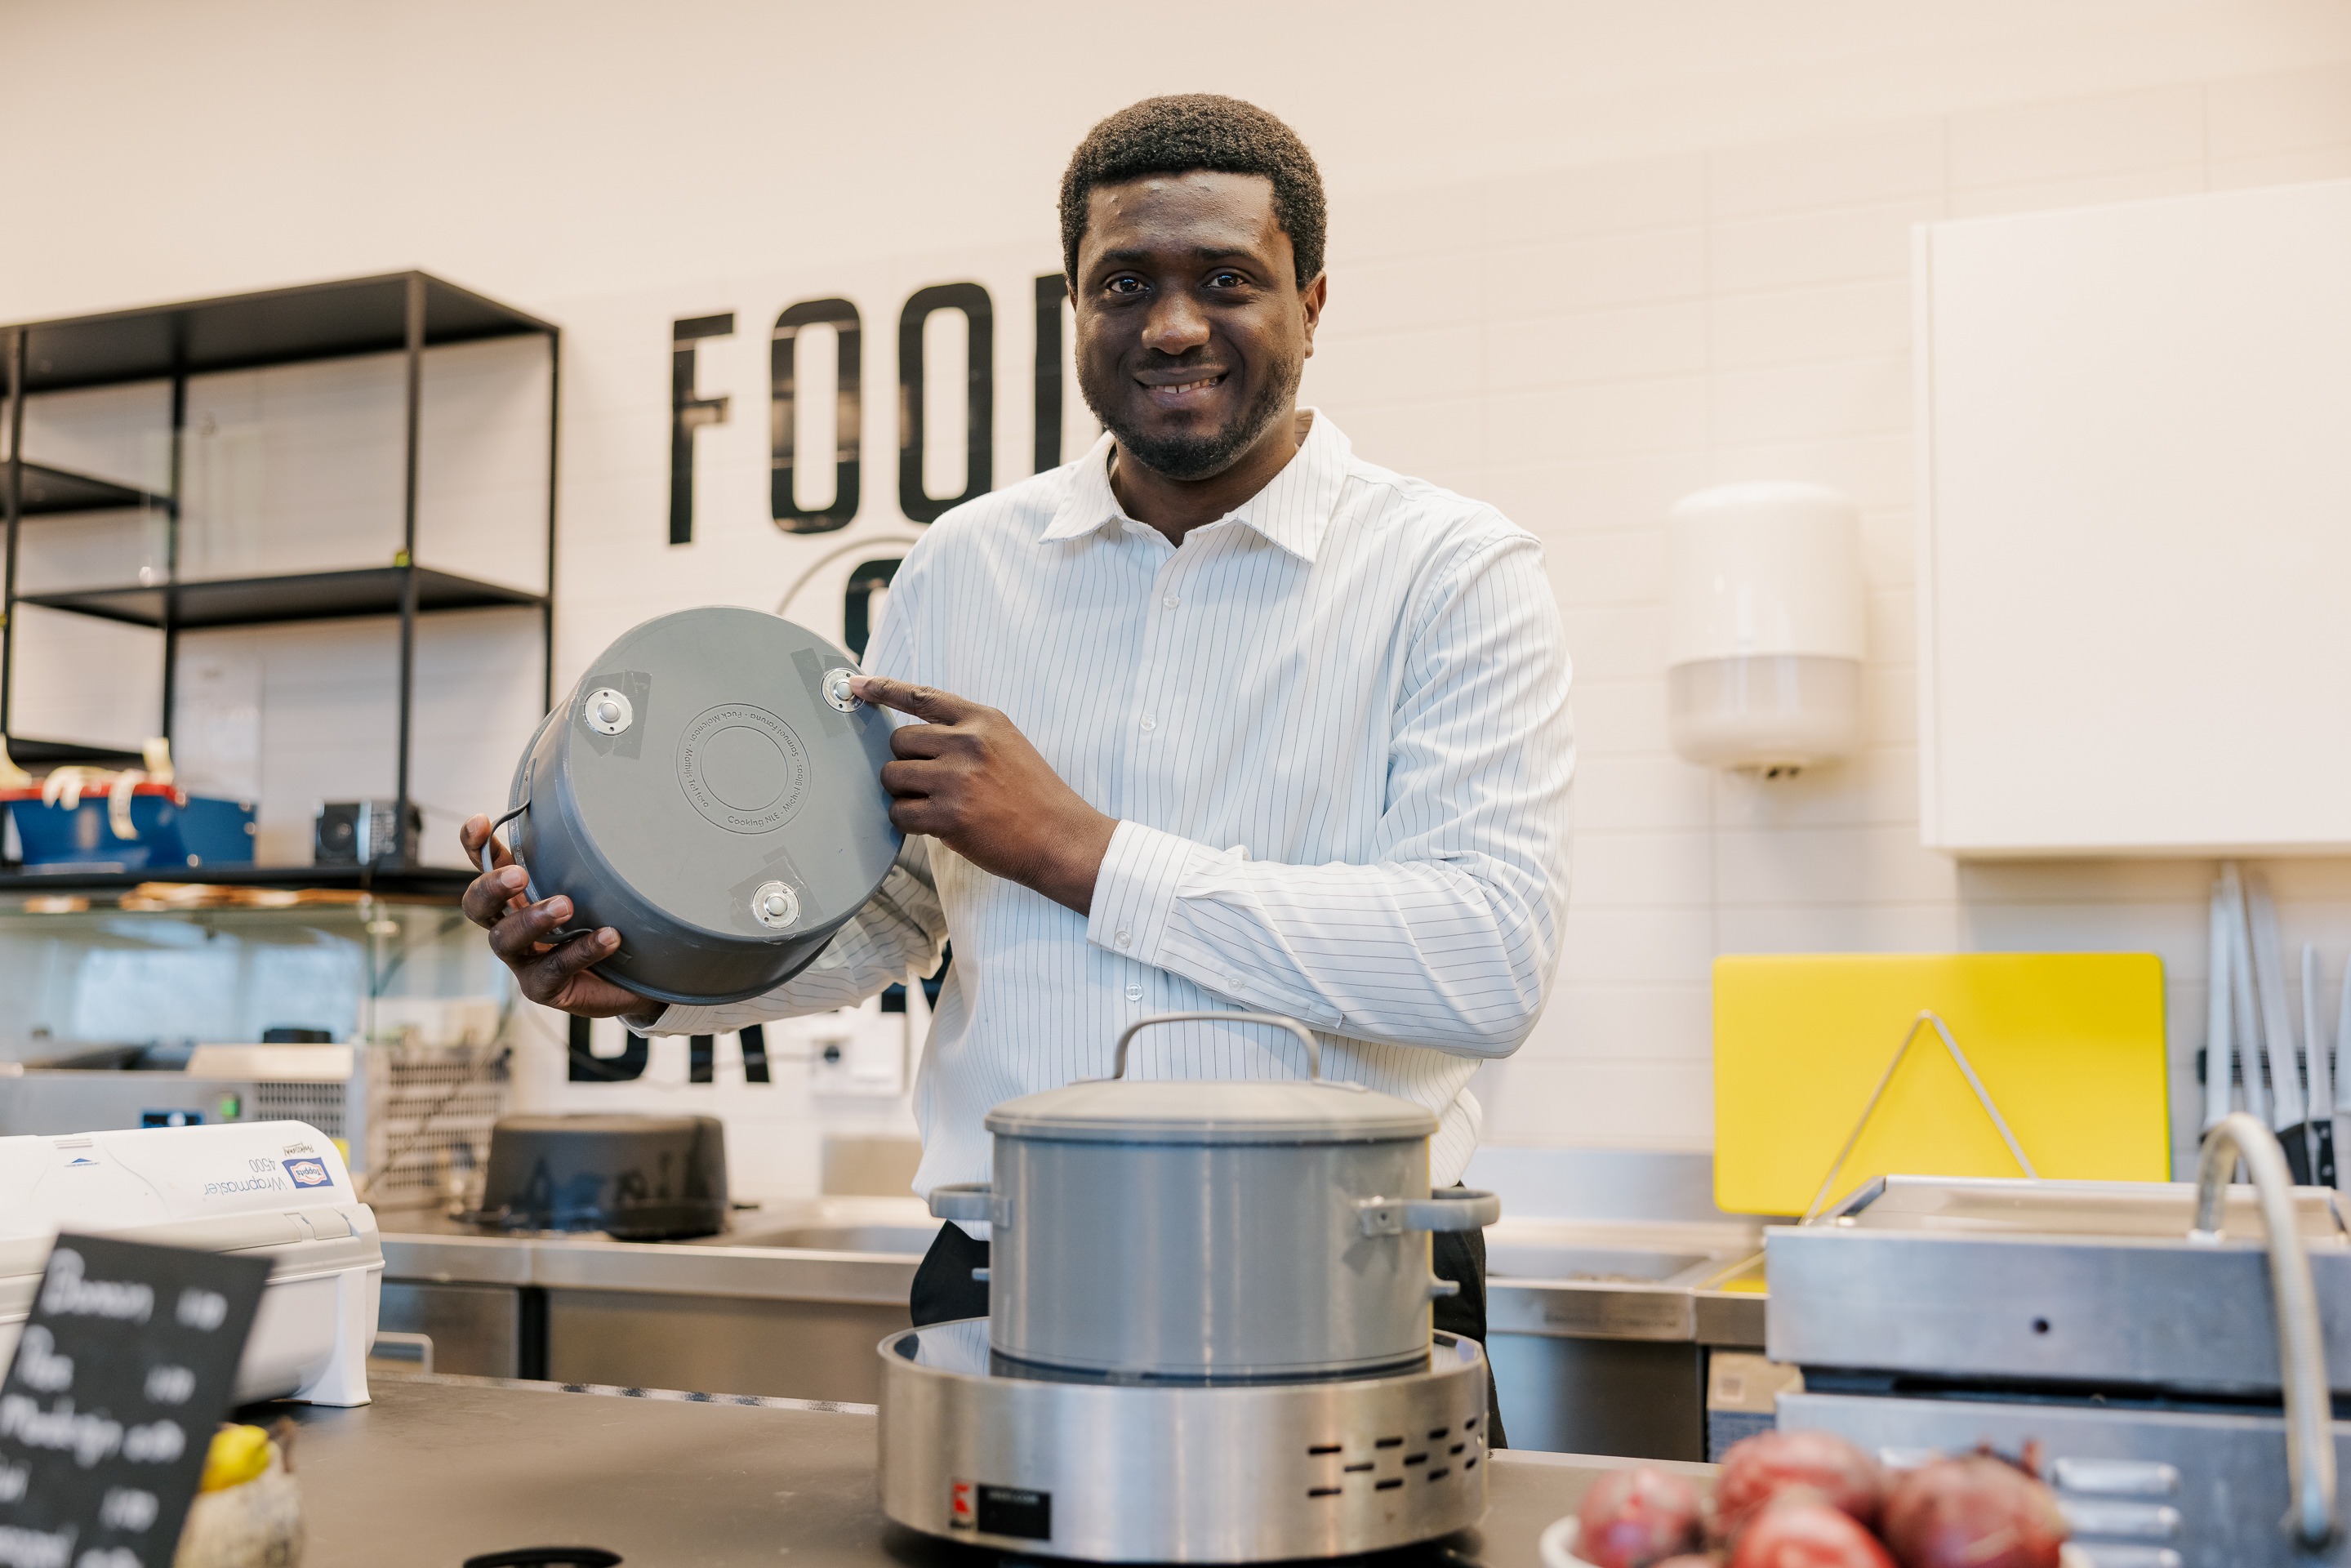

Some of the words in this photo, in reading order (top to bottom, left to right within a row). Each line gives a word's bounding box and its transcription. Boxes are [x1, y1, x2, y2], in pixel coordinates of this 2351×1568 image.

[720, 711, 742, 719] Puck
[750, 713, 778, 731] Faruna
[690, 715, 721, 742] Molenaar
[777, 728, 799, 757] Samuel
[795, 764, 804, 786] Blaas
[782, 786, 801, 813] Michel
[728, 815, 764, 826] Cooking
[764, 812, 780, 824] NLE
[248, 1157, 276, 1173] 4500
[296, 1166, 322, 1177] Toppits
[204, 1176, 287, 1195] Wrapmaster
